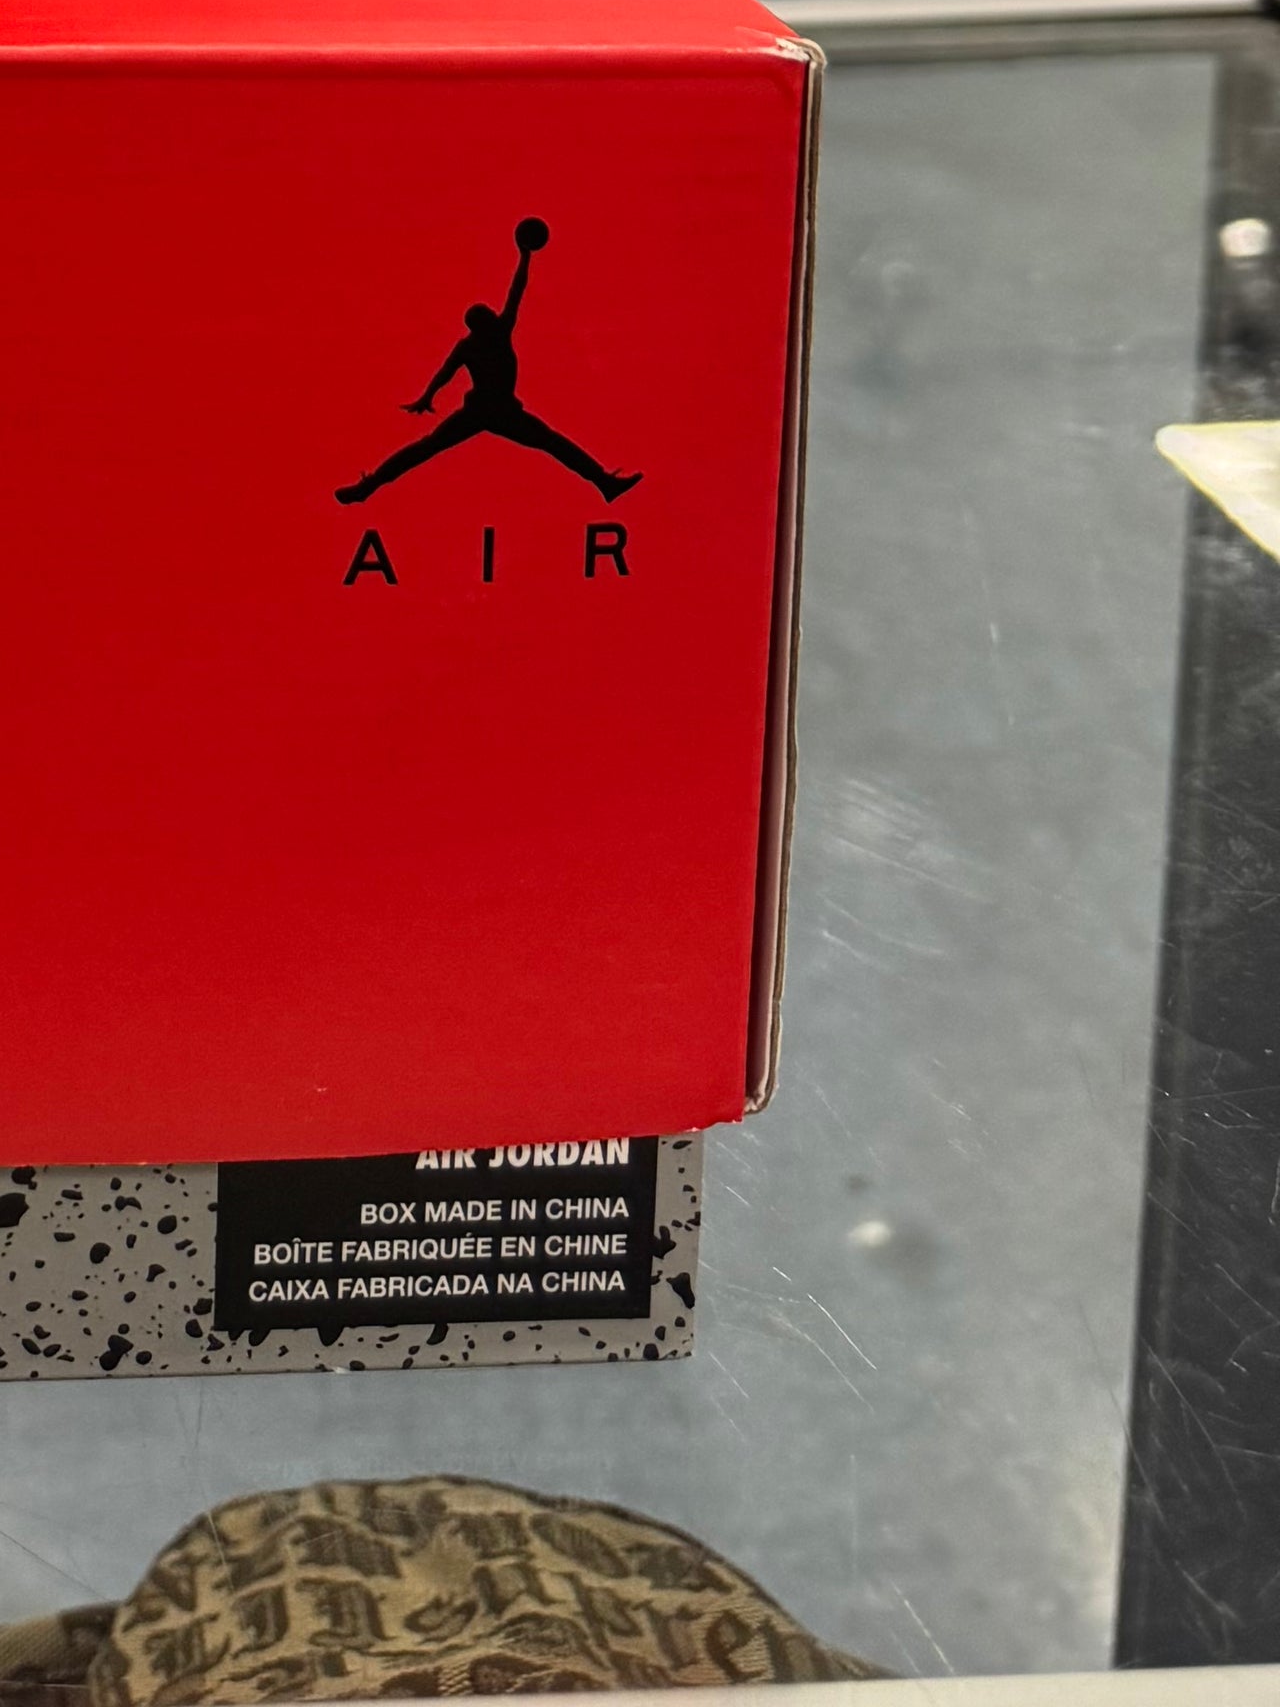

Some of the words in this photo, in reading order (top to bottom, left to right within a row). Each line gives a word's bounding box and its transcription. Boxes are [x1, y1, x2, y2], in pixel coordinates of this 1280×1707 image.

[342, 521, 630, 587] AIR
[415, 1148, 477, 1170] AIR
[488, 1137, 630, 1168] JORDAN
[360, 1202, 417, 1225] BOX
[425, 1199, 503, 1223] MADE
[511, 1198, 536, 1221] IN
[544, 1196, 630, 1220] CHINA
[253, 1235, 333, 1265] BOÎTE
[341, 1231, 493, 1263] FABRIQUÉE
[500, 1236, 536, 1259] EN
[544, 1233, 628, 1257] CHINE
[248, 1278, 330, 1302] CAIXA
[338, 1273, 490, 1300] FABRICADA
[497, 1273, 534, 1296] NA
[542, 1270, 626, 1293] CHINA
